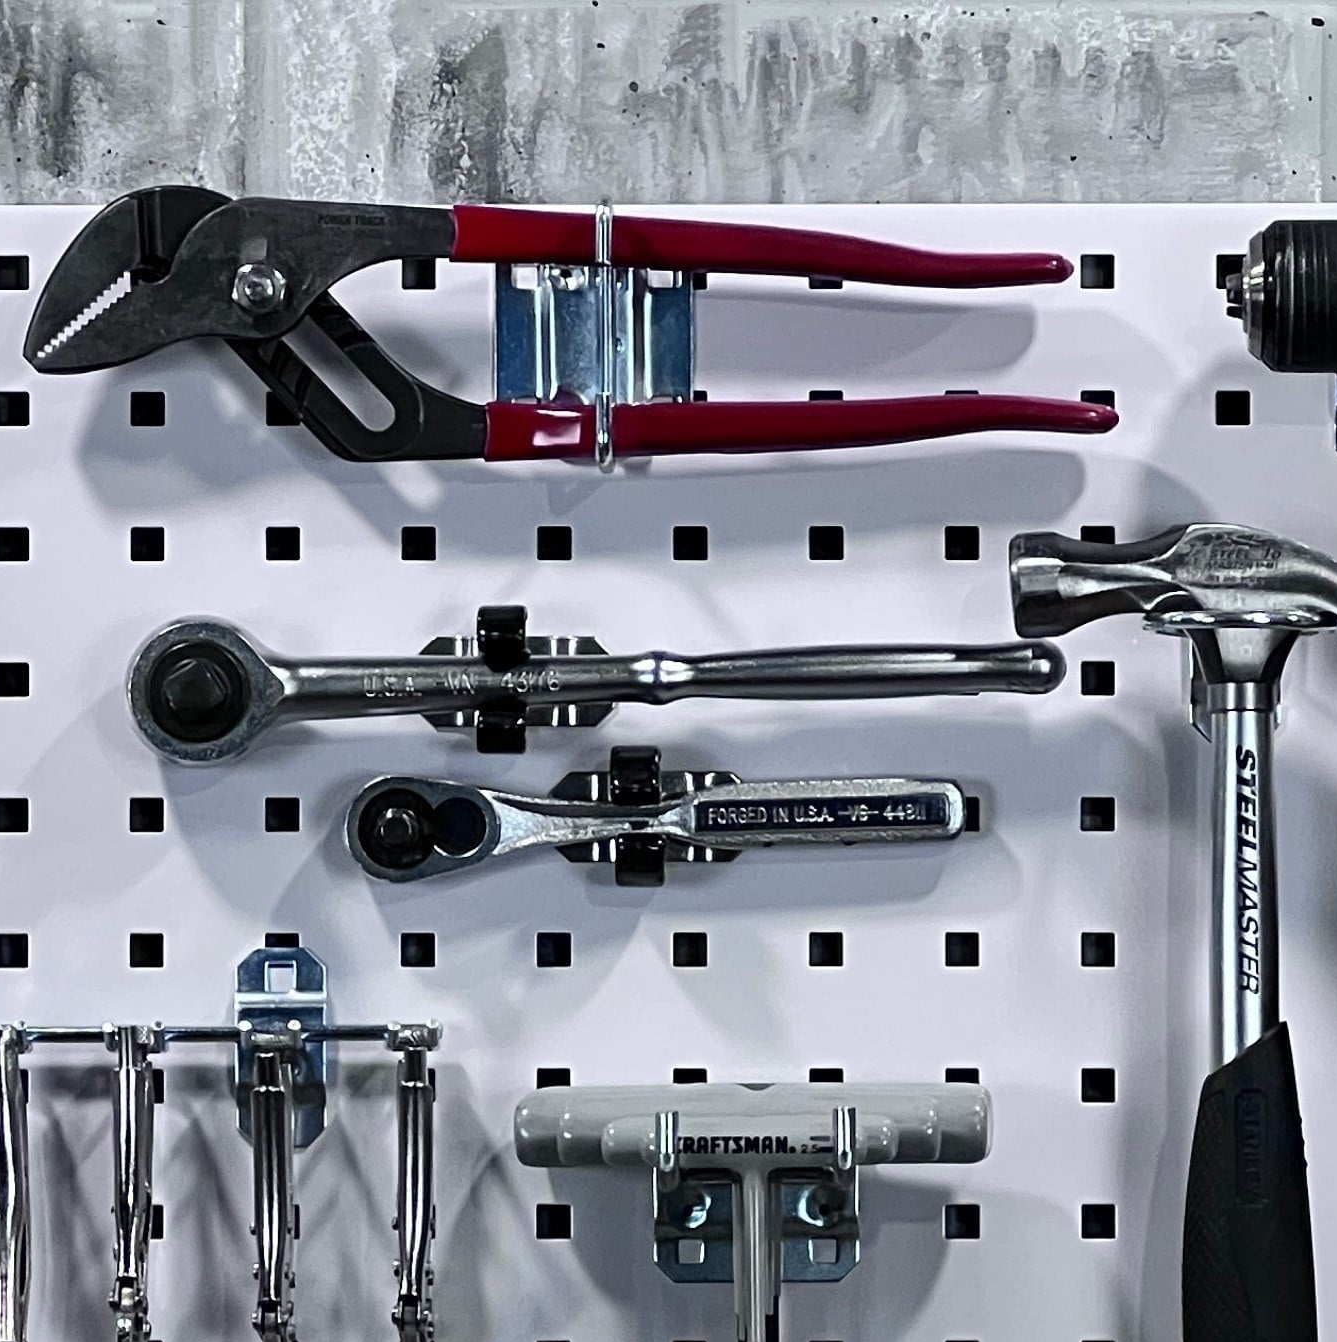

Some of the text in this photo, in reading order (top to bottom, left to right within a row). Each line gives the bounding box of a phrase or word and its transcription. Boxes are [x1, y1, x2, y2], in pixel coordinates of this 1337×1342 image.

[707, 807, 767, 825] FORGED
[773, 805, 789, 823] IN
[1235, 744, 1259, 994] STEELMASTER
